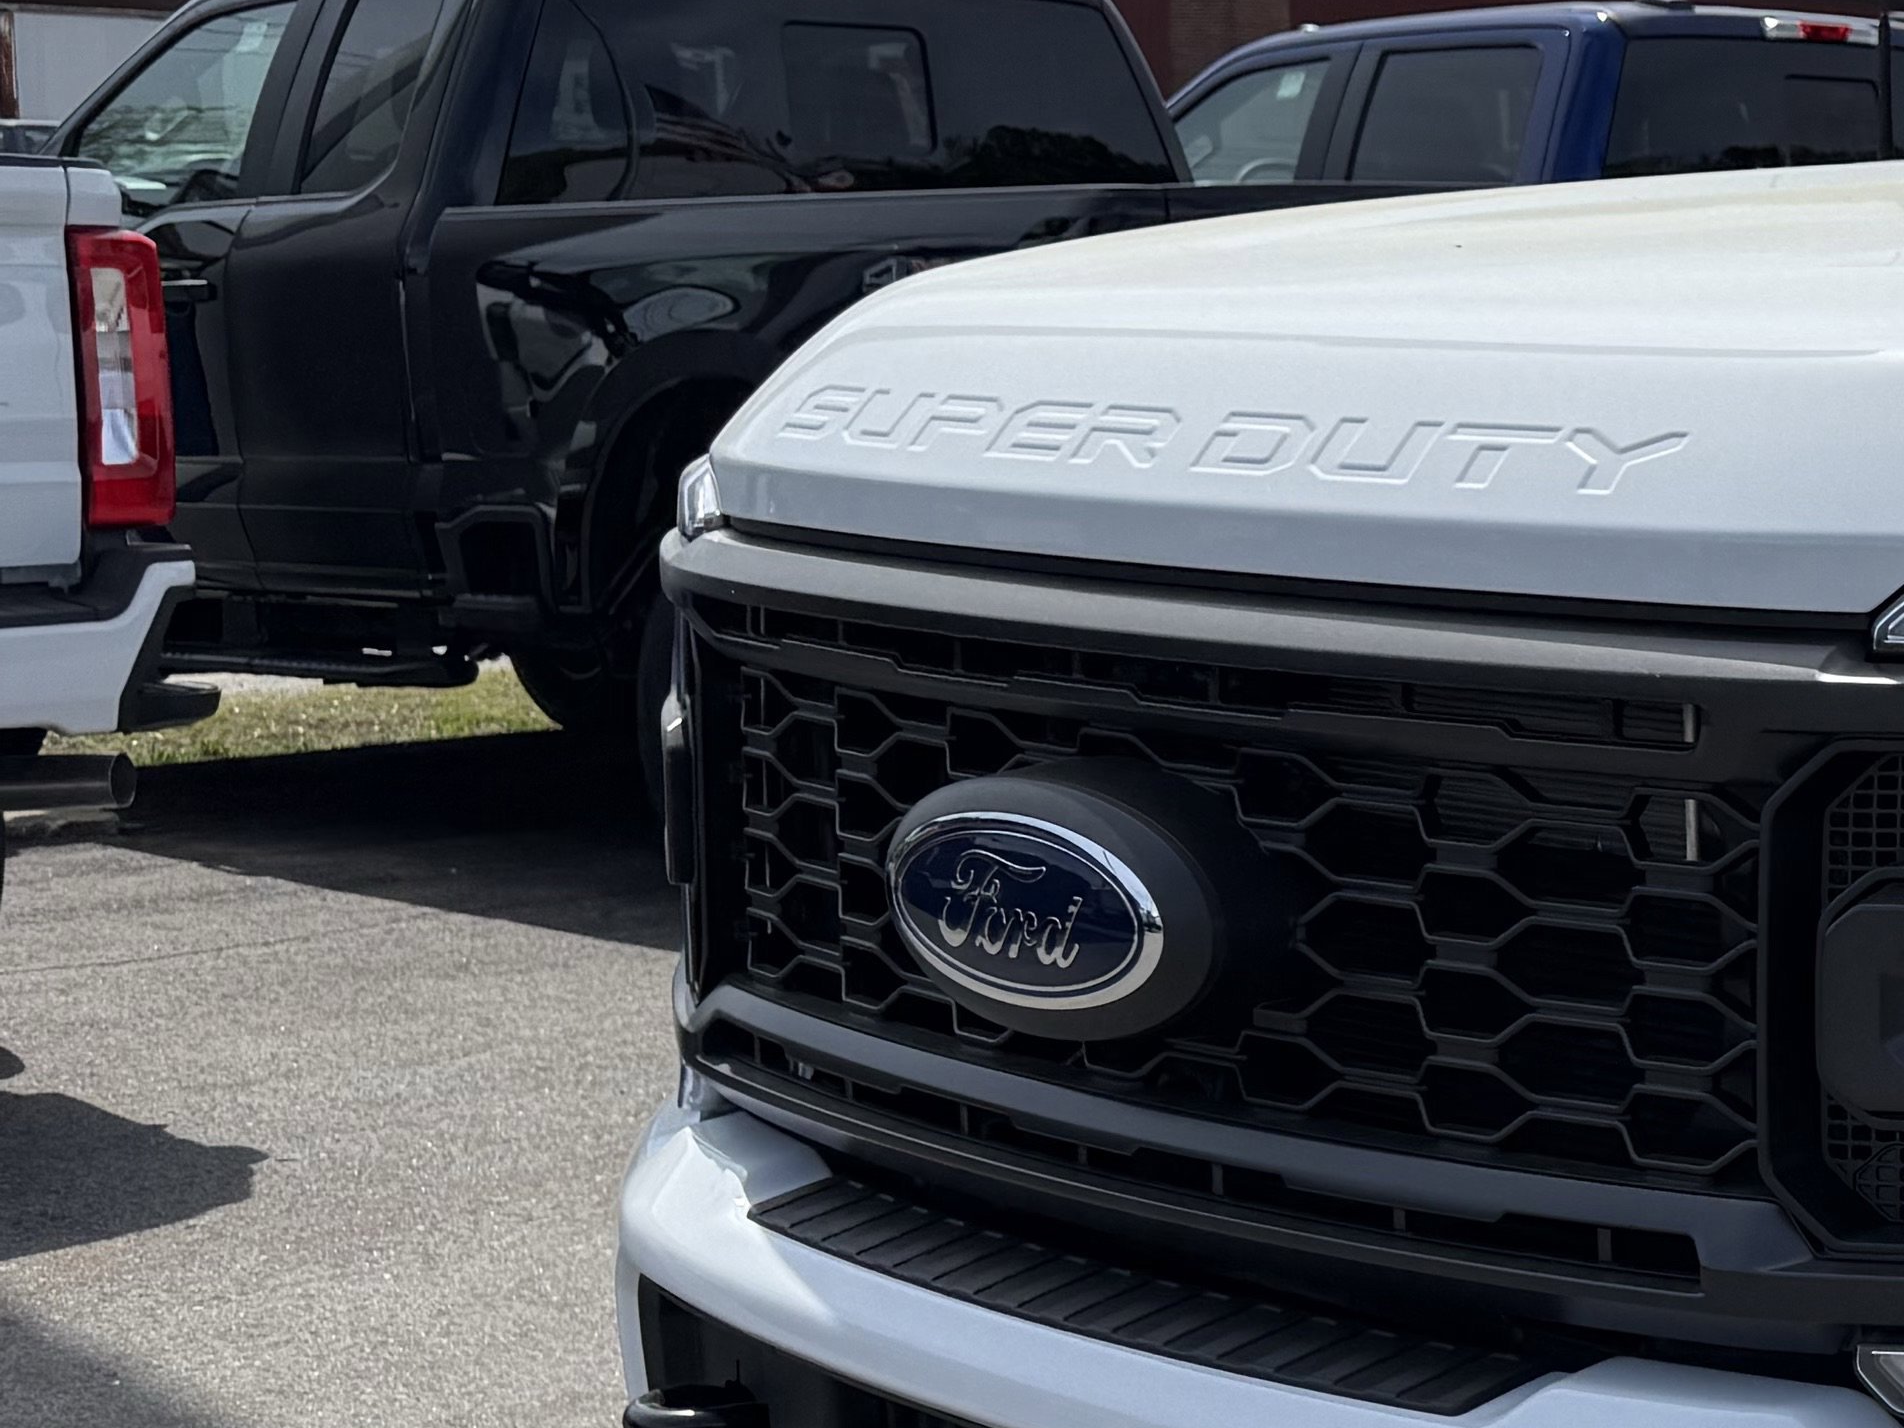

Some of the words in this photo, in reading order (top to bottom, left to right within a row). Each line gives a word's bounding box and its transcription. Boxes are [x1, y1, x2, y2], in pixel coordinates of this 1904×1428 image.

[776, 384, 1183, 469] SUPER
[1188, 412, 1689, 495] DUTY
[938, 849, 1083, 968] Ford
